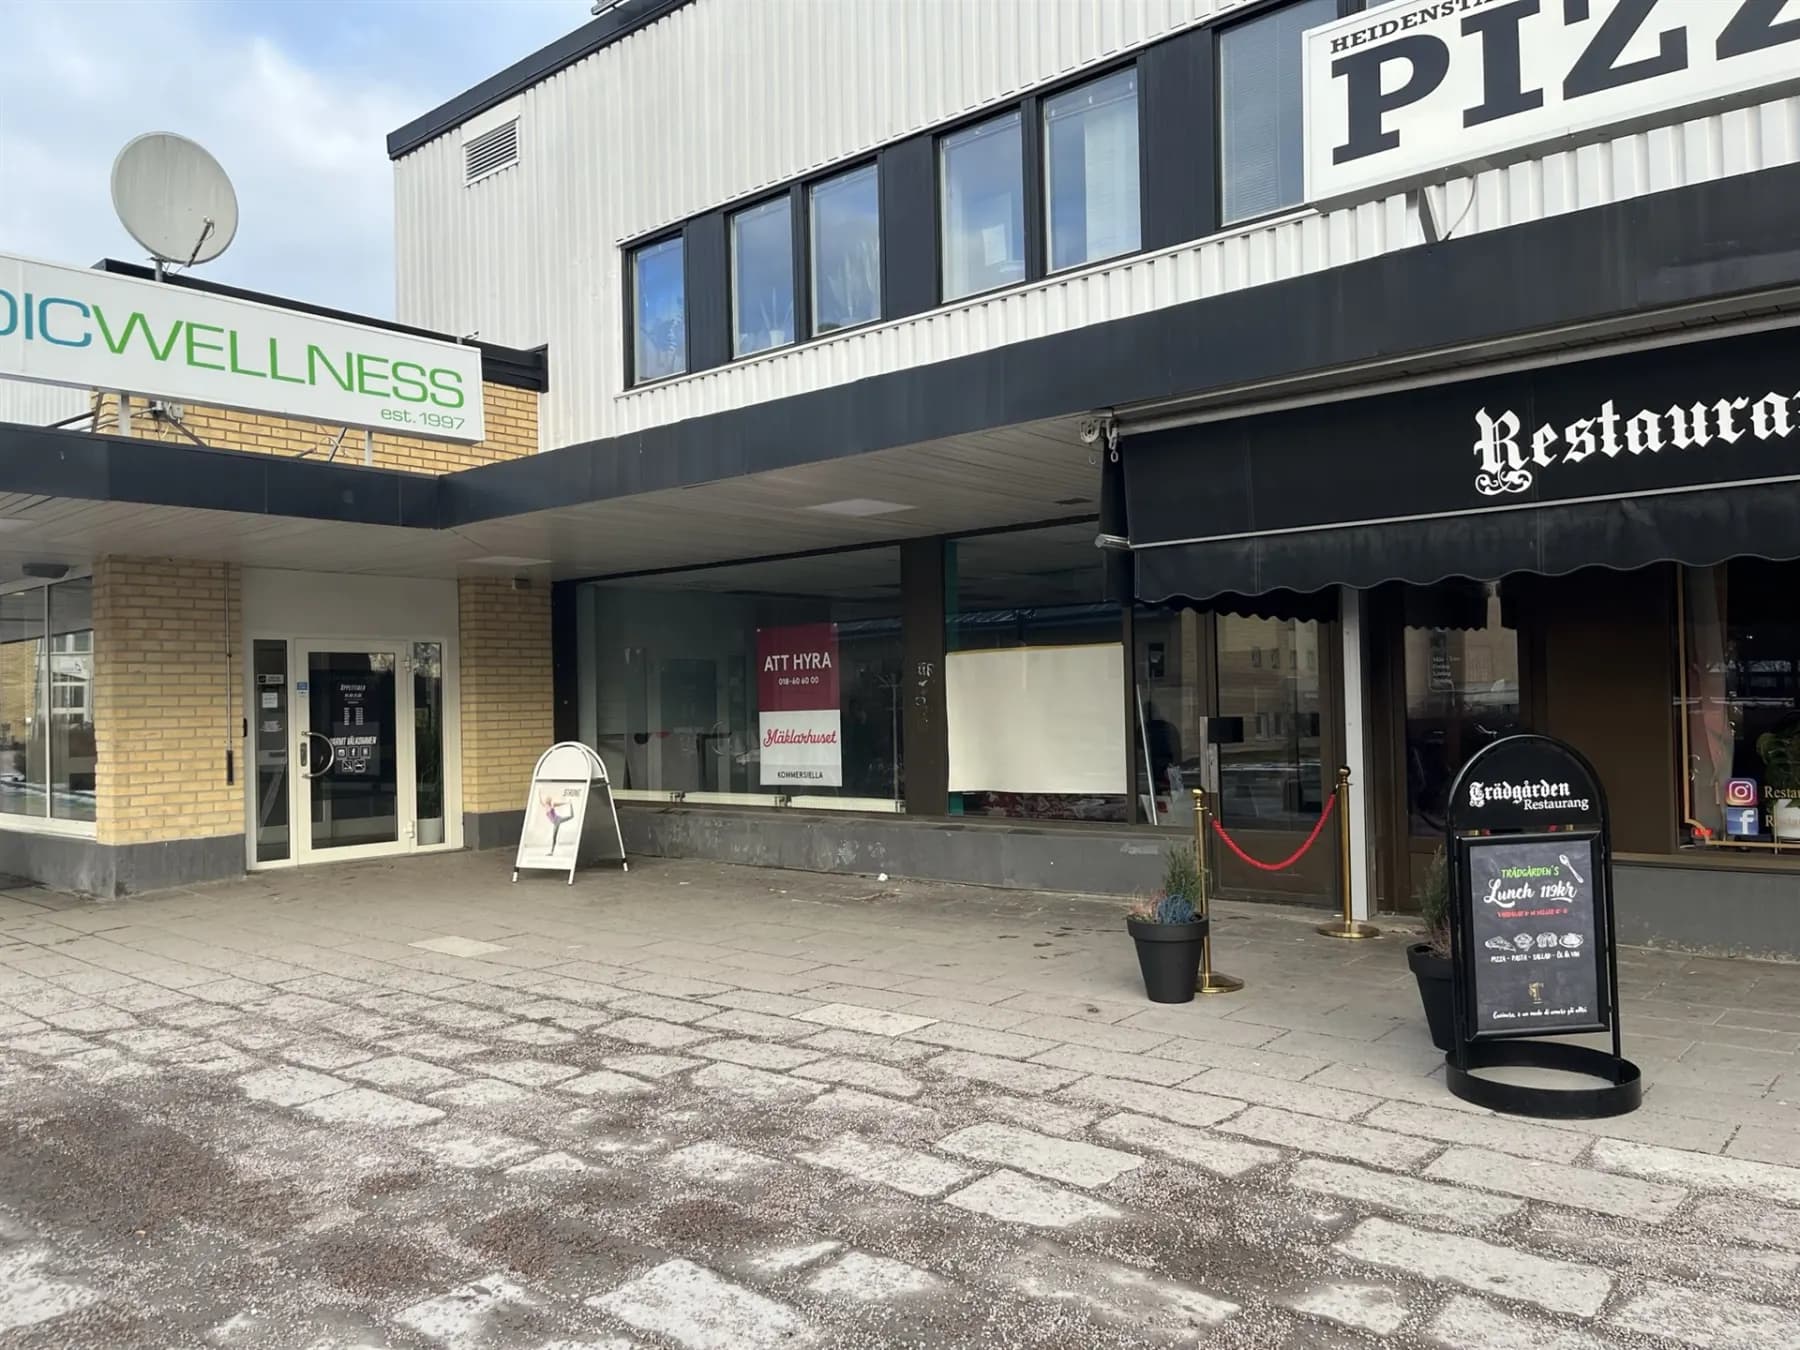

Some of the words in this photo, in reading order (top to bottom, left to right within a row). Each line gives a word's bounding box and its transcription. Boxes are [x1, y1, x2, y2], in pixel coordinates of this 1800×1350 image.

[380, 405, 415, 424] est.
[419, 412, 465, 431] 1997
[764, 655, 789, 672] ATT
[793, 652, 832, 671] HYRA
[763, 728, 837, 748] Mäklarhuset
[777, 770, 823, 779] KOMMERSIELLA
[1469, 779, 1570, 808] Trädgården
[1524, 798, 1589, 811] Restaurang
[1483, 878, 1536, 908] Lunch
[1540, 880, 1577, 900] 119kr
